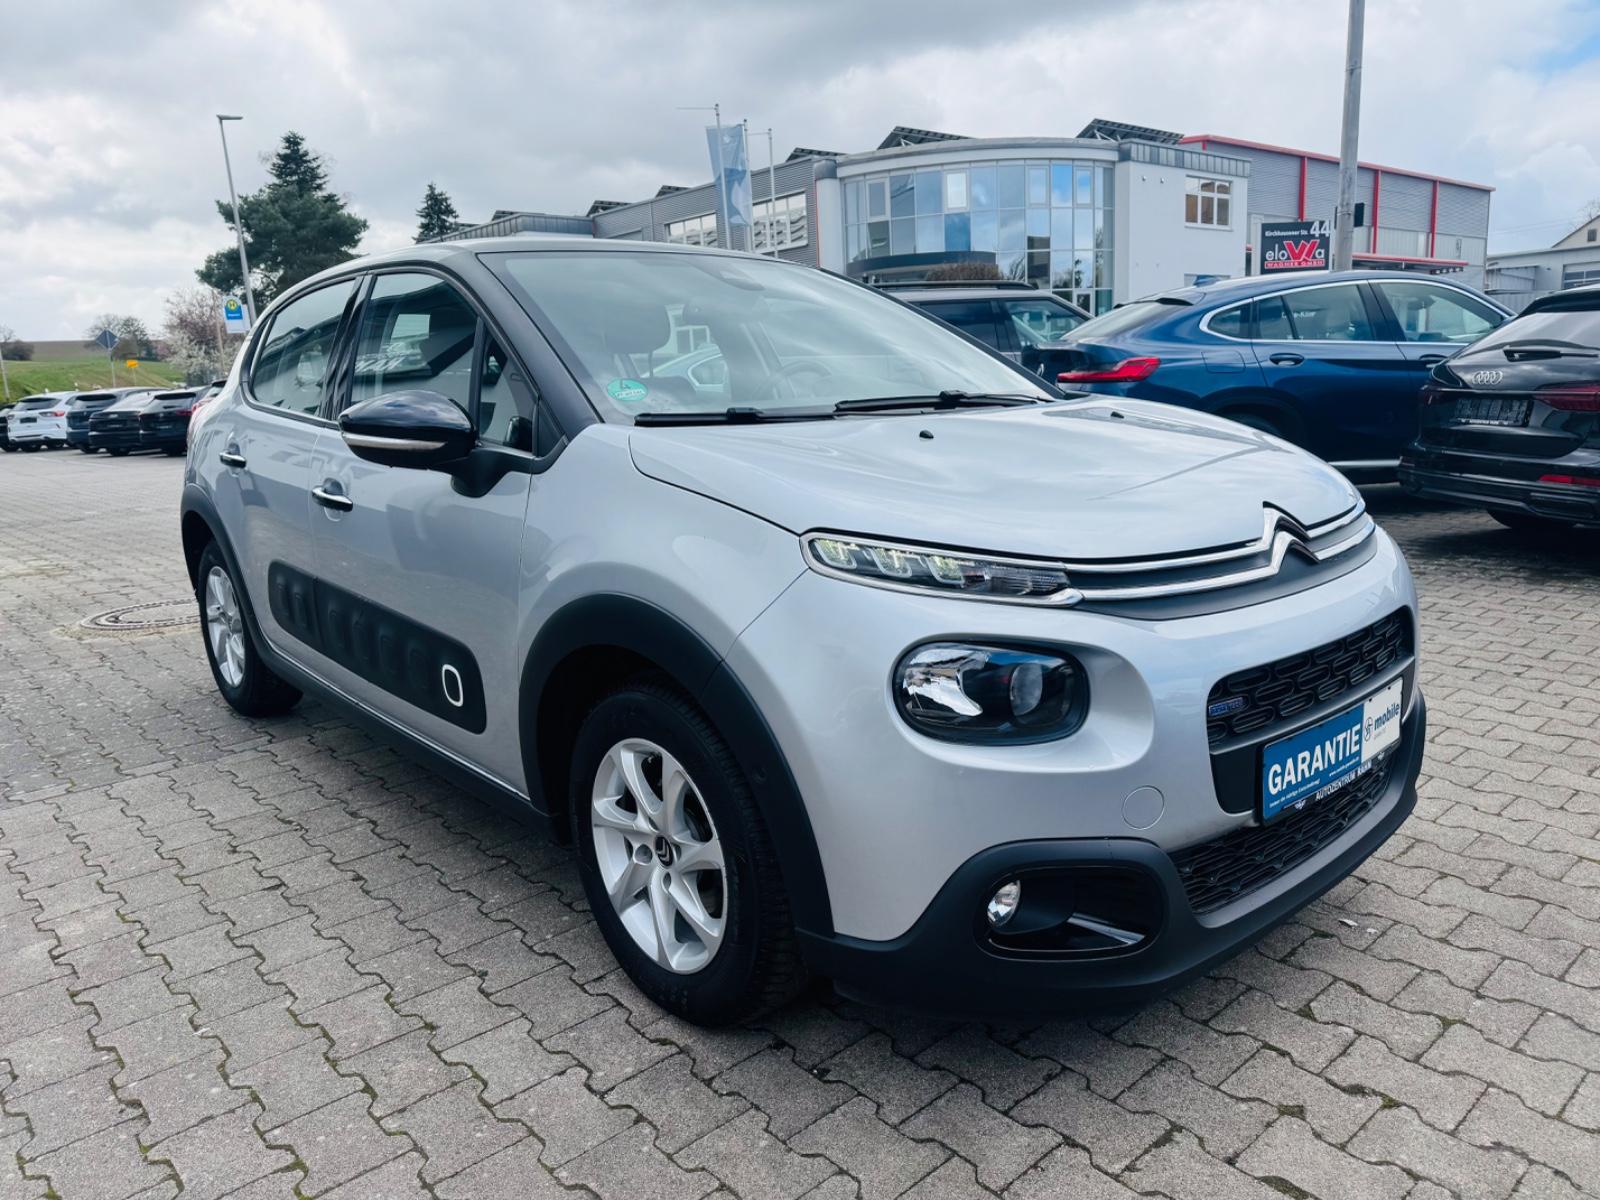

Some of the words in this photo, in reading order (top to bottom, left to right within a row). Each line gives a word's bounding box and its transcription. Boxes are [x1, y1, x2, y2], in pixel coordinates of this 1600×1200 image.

[1310, 220, 1331, 237] 44
[1374, 703, 1400, 731] mobile
[1267, 723, 1361, 795] GARANTIE
[1315, 771, 1356, 801] AUTOZENTRUM
